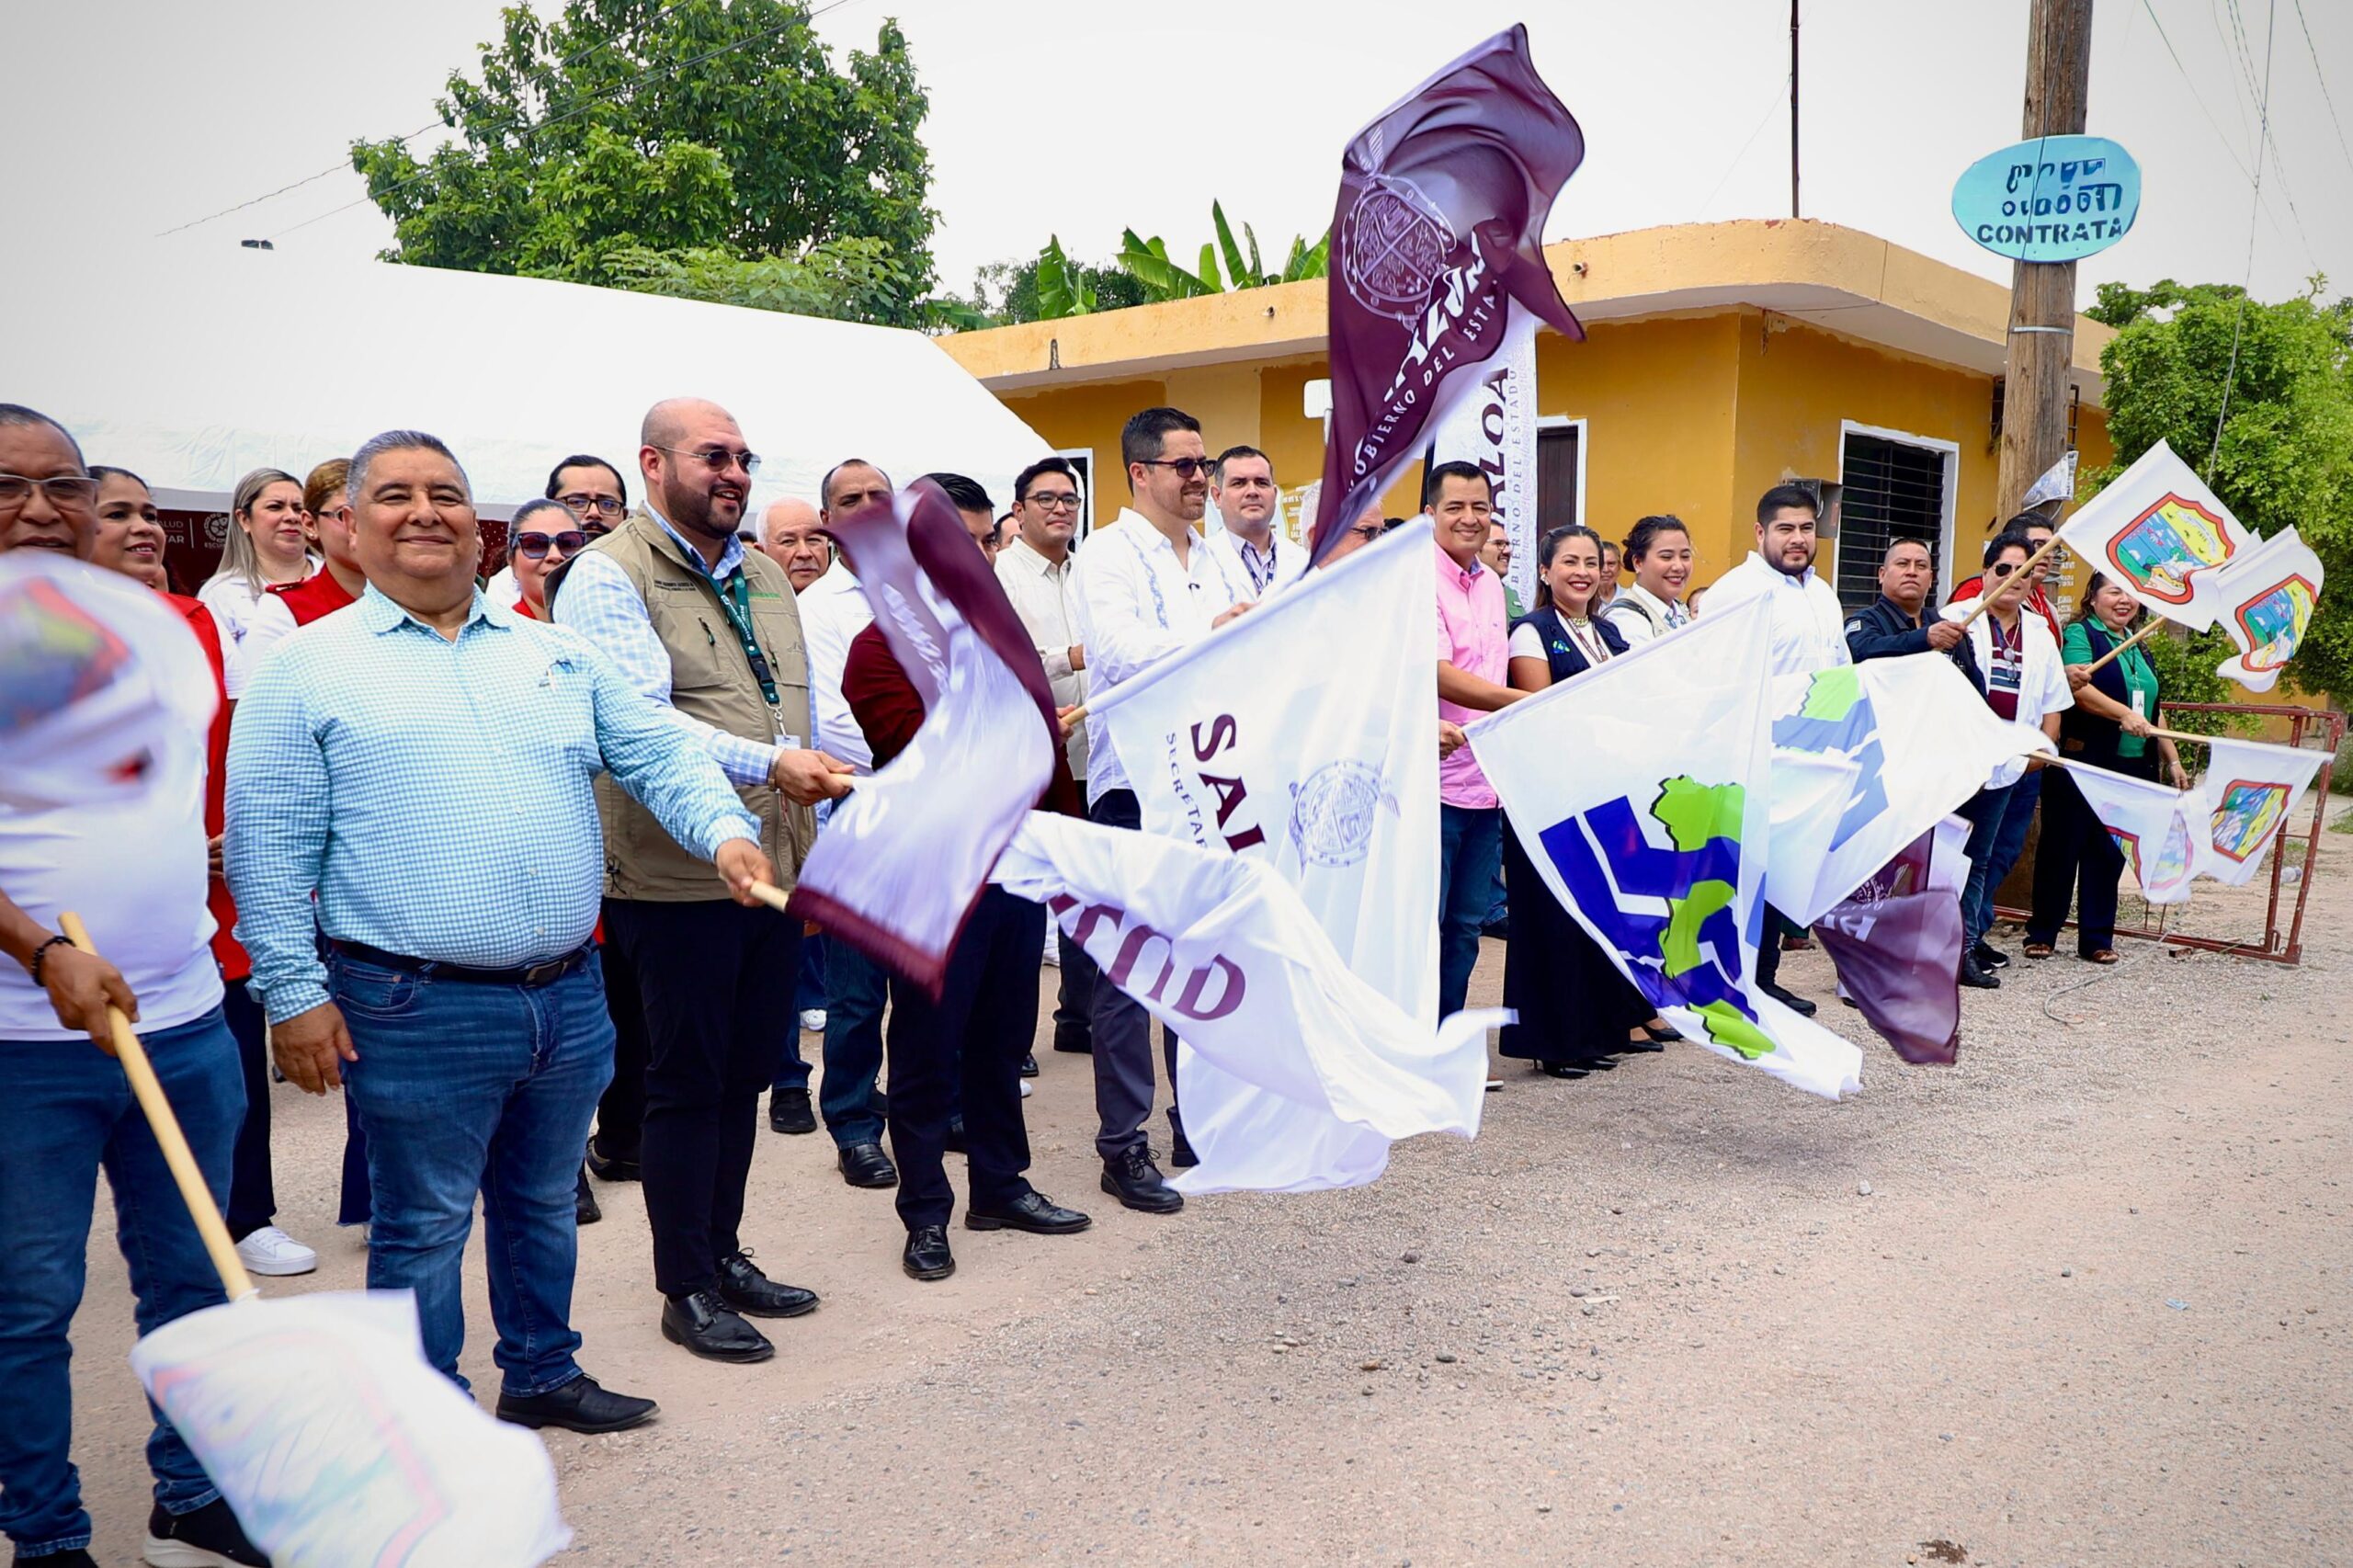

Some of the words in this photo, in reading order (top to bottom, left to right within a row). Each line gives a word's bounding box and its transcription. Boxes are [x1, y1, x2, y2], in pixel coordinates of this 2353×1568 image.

[1977, 217, 2122, 244] CONTRATA
[1349, 389, 1416, 478] OBIERNO
[1423, 346, 1455, 387] DEL
[1462, 292, 1496, 342] ESTA
[1512, 459, 1522, 494] DEL
[1510, 507, 1521, 584] BIERNO
